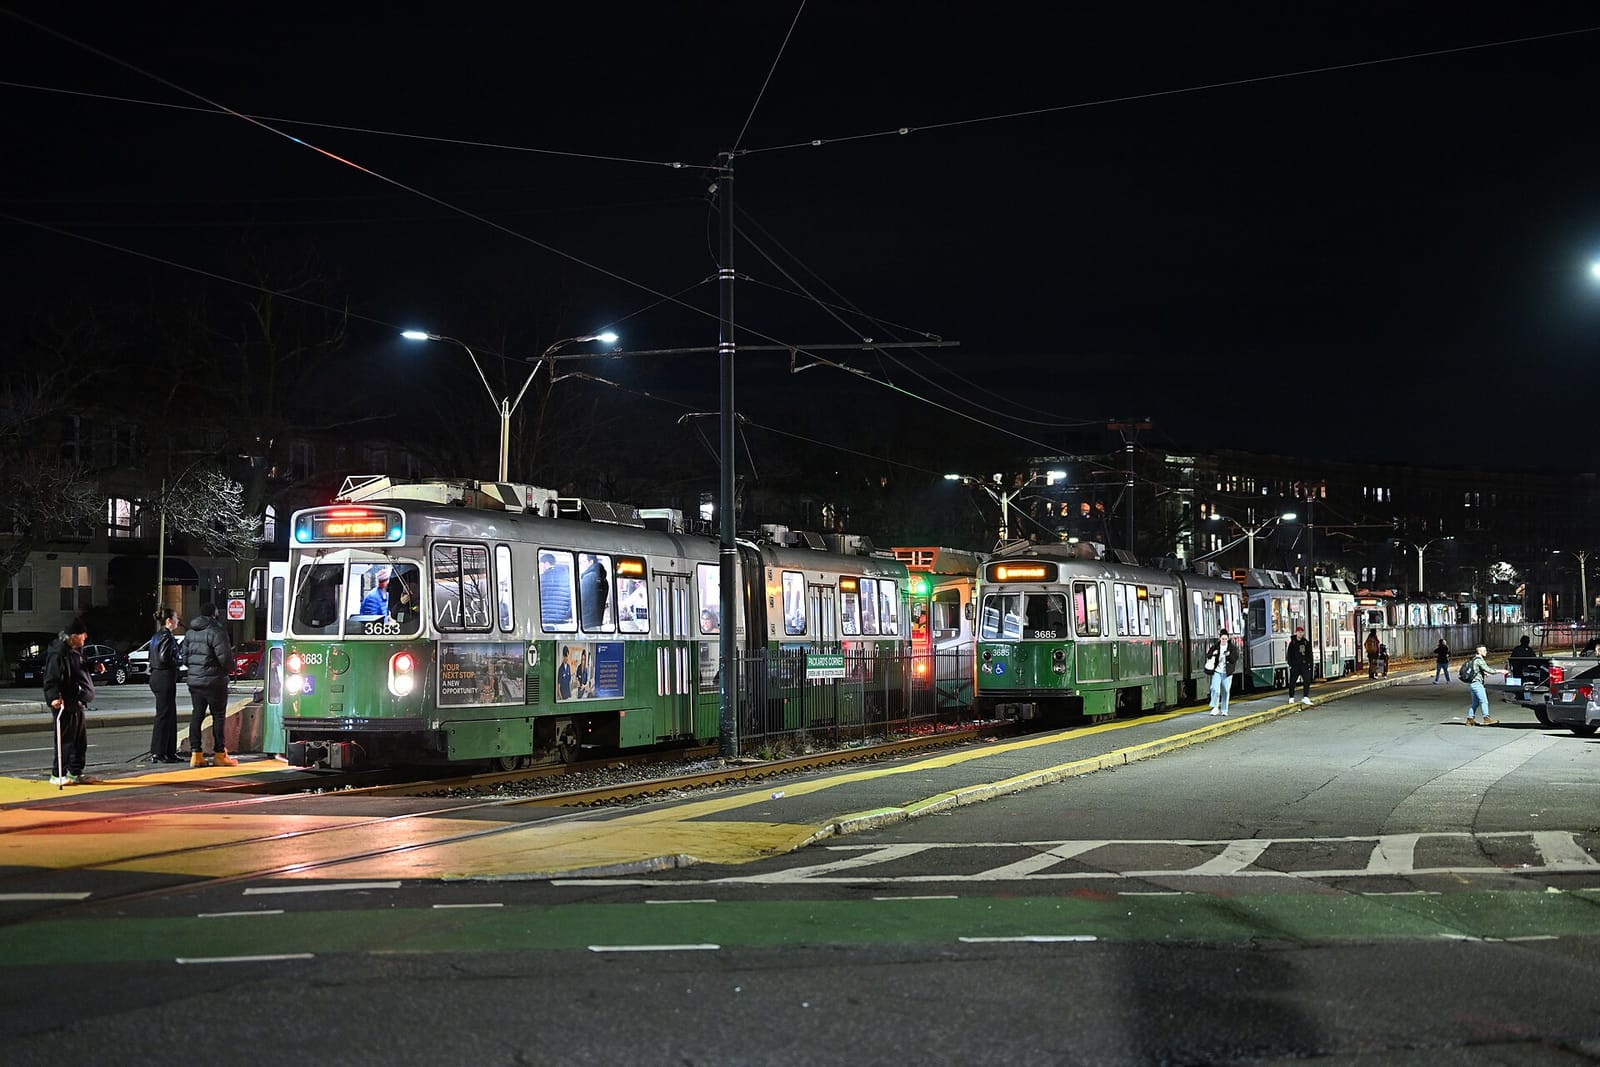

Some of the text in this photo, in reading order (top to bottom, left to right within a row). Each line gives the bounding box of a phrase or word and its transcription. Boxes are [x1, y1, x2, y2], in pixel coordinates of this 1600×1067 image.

[364, 622, 401, 635] 3683
[1034, 630, 1057, 639] 3685
[992, 649, 1010, 657] 3685
[442, 663, 460, 672] YOUR
[442, 671, 459, 680] NEXT
[442, 687, 479, 695] OPPORTUNITY
